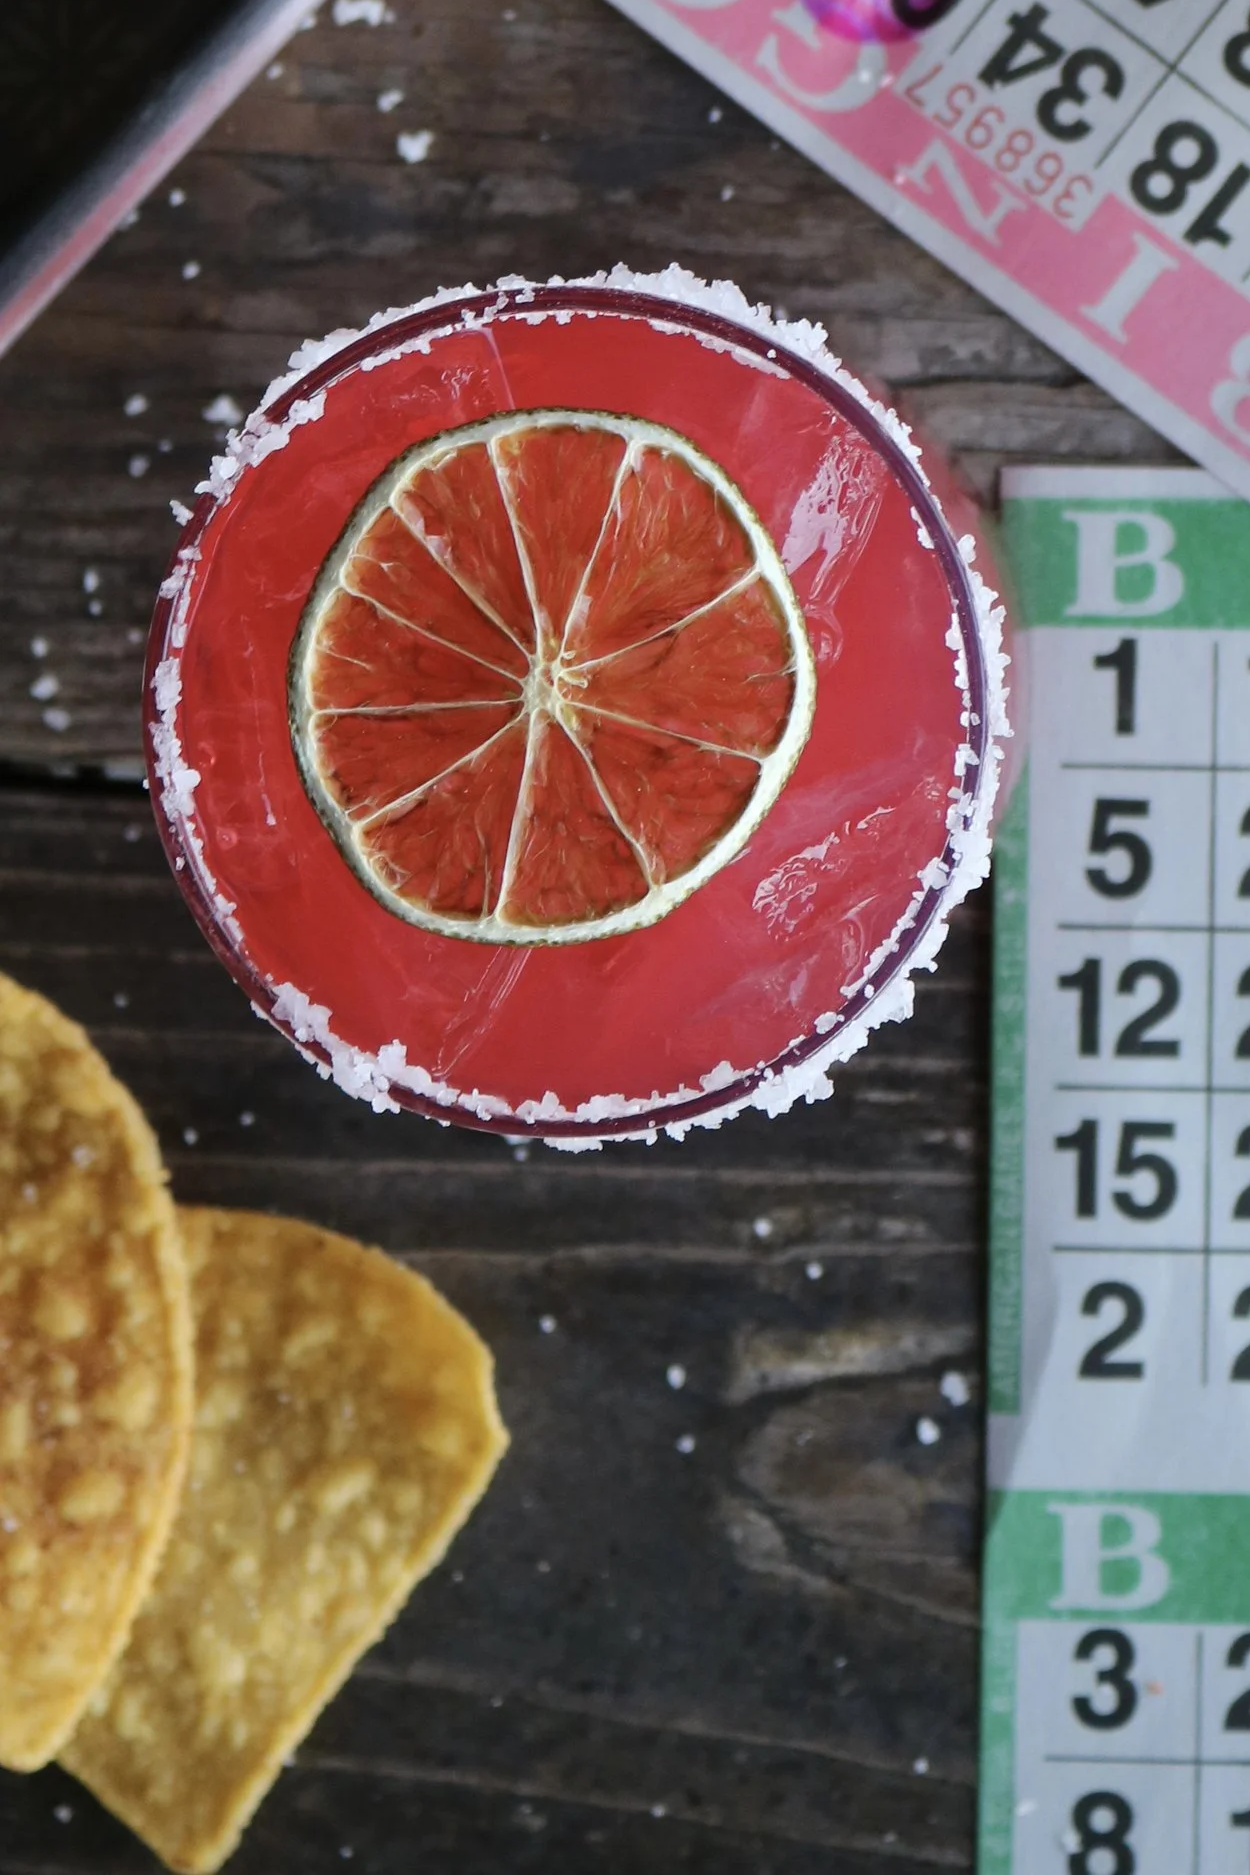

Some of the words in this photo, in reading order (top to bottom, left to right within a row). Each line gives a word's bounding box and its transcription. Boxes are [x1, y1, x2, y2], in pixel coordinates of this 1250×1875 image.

[976, 0, 1125, 142] 34
[899, 54, 1098, 223] 368957
[1094, 638, 1137, 735] 1
[1085, 798, 1152, 900] 5
[1058, 958, 1180, 1057] 12
[1054, 1119, 1178, 1221] 15
[1078, 1281, 1145, 1380] 2
[1072, 1628, 1138, 1730] 3
[1069, 1792, 1136, 1875] 8
